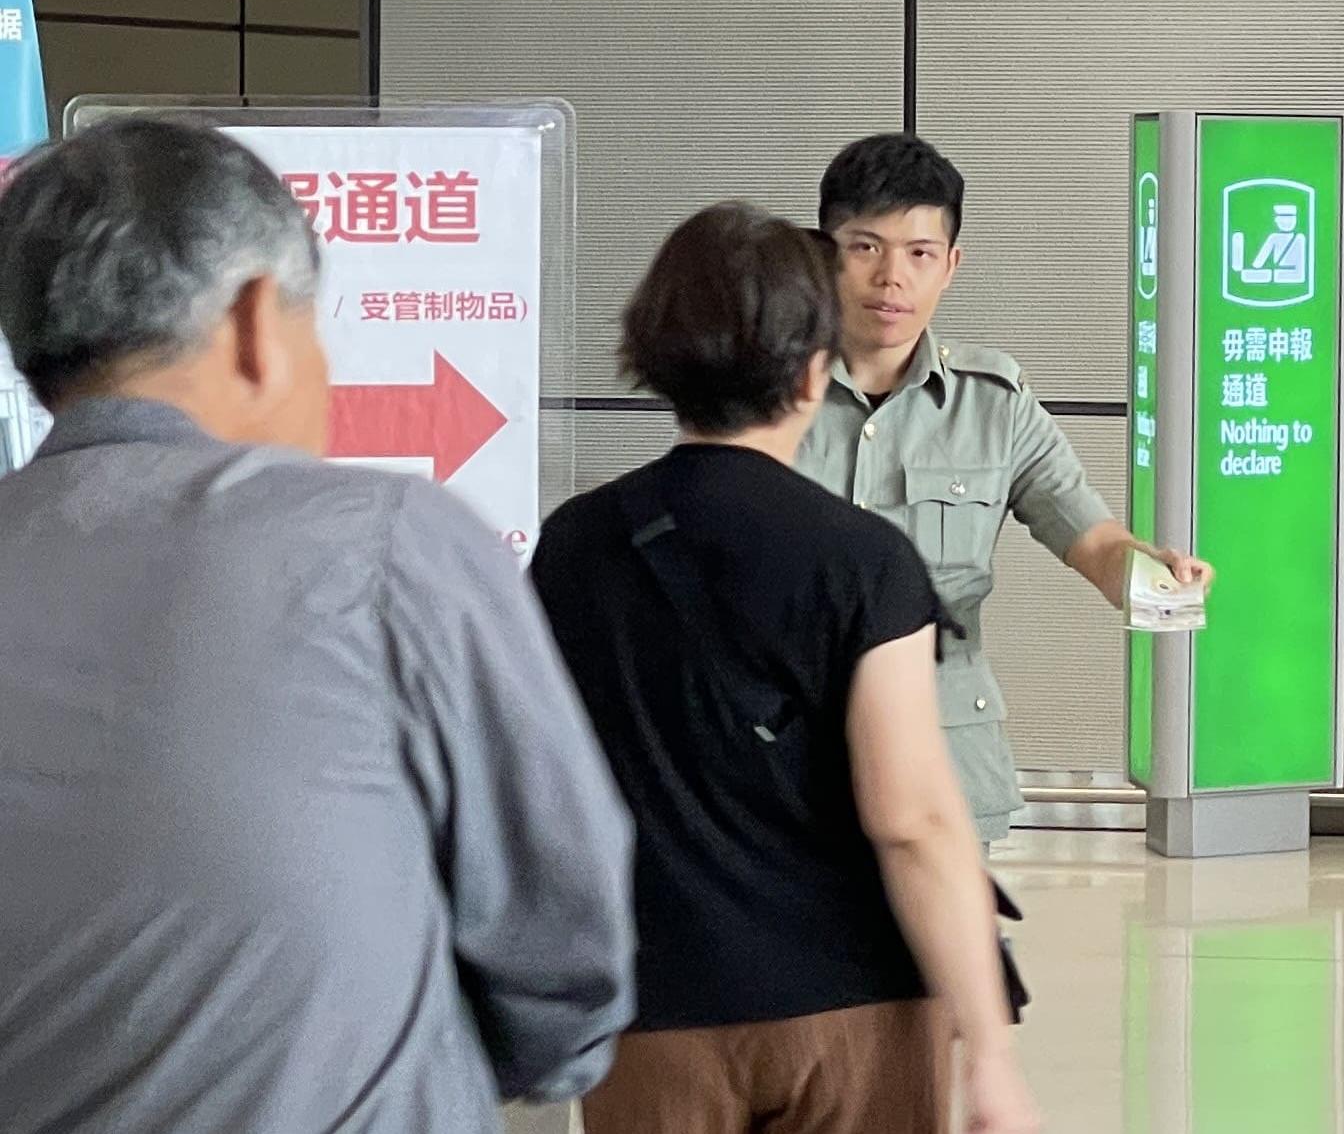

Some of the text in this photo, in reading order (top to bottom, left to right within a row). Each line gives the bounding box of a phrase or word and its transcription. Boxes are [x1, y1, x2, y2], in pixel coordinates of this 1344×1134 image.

[282, 171, 480, 244] 通道
[360, 291, 528, 322] 受管制物品)
[1220, 327, 1313, 363] 毋需申報
[1221, 372, 1268, 407] 通道
[1220, 417, 1313, 452] Nothing to
[1220, 449, 1282, 476] declare
